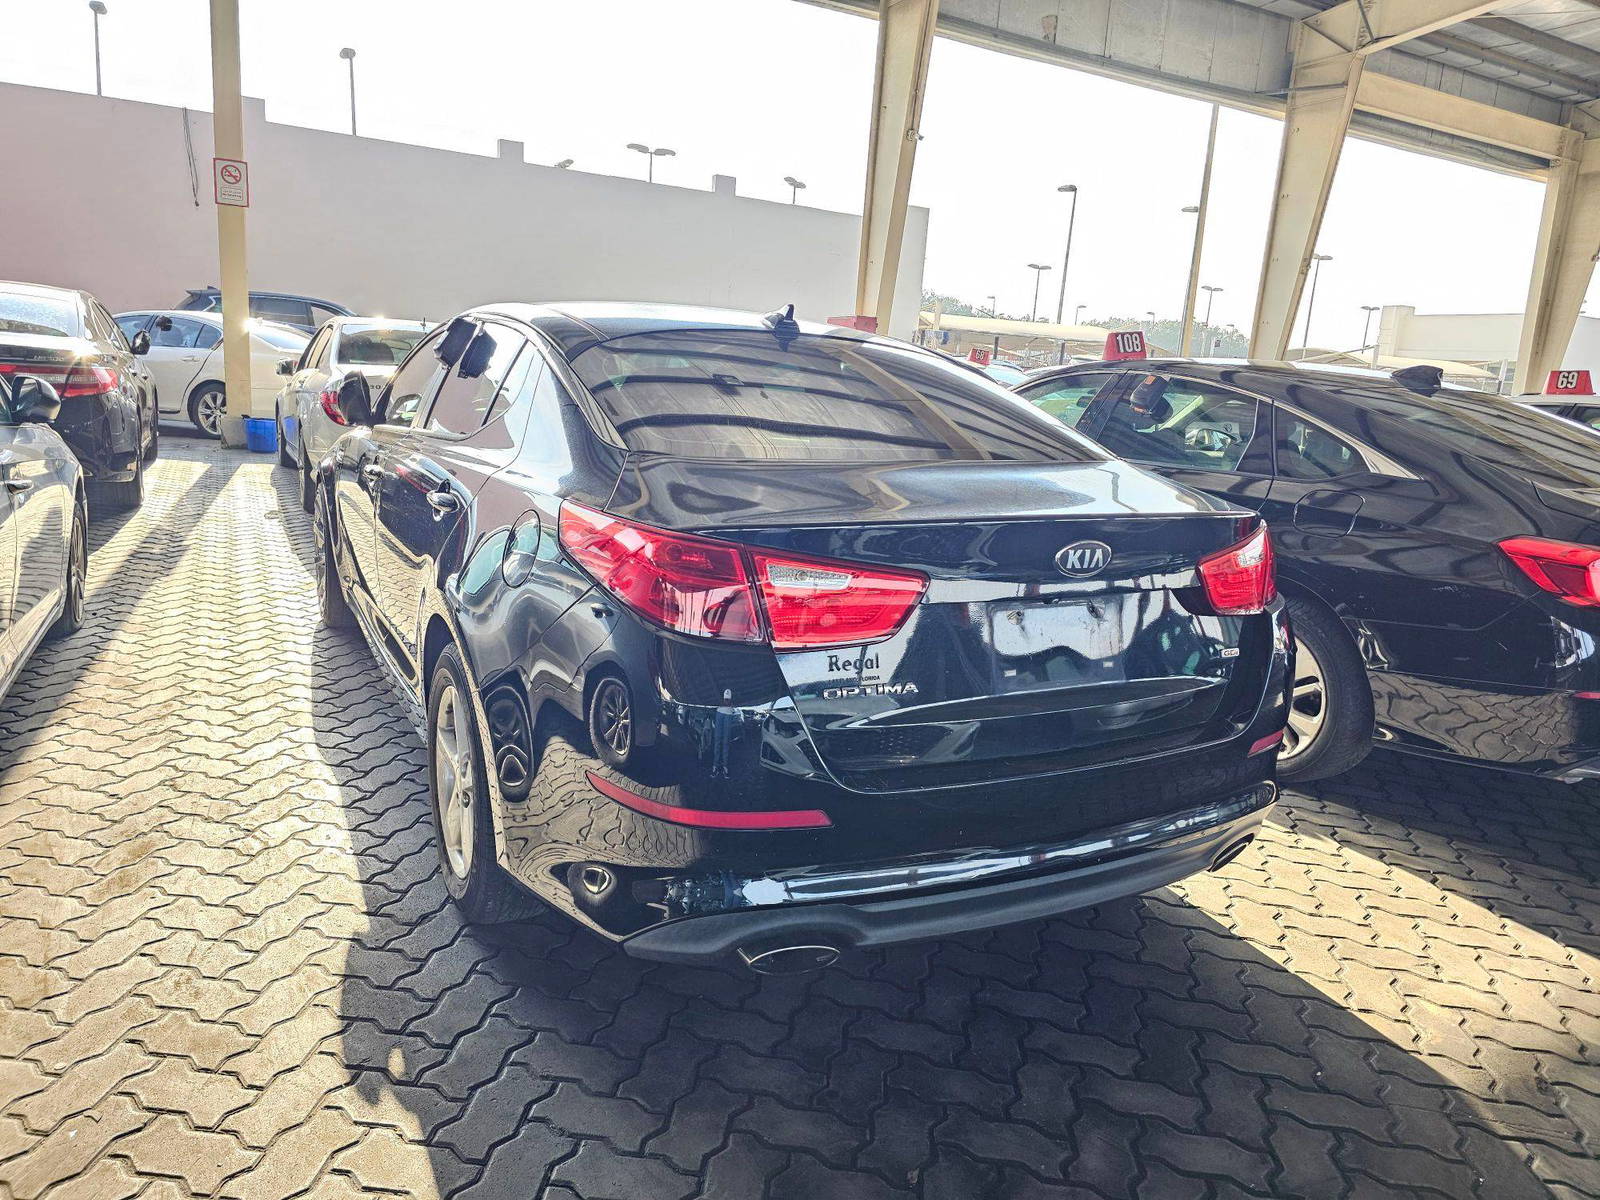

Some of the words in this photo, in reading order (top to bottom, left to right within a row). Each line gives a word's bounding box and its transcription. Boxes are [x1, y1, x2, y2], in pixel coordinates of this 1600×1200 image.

[1116, 333, 1142, 353] 108
[1557, 371, 1578, 389] 69
[1066, 548, 1103, 569] KIA
[827, 652, 880, 675] Regal
[823, 683, 919, 700] OPTIMA
